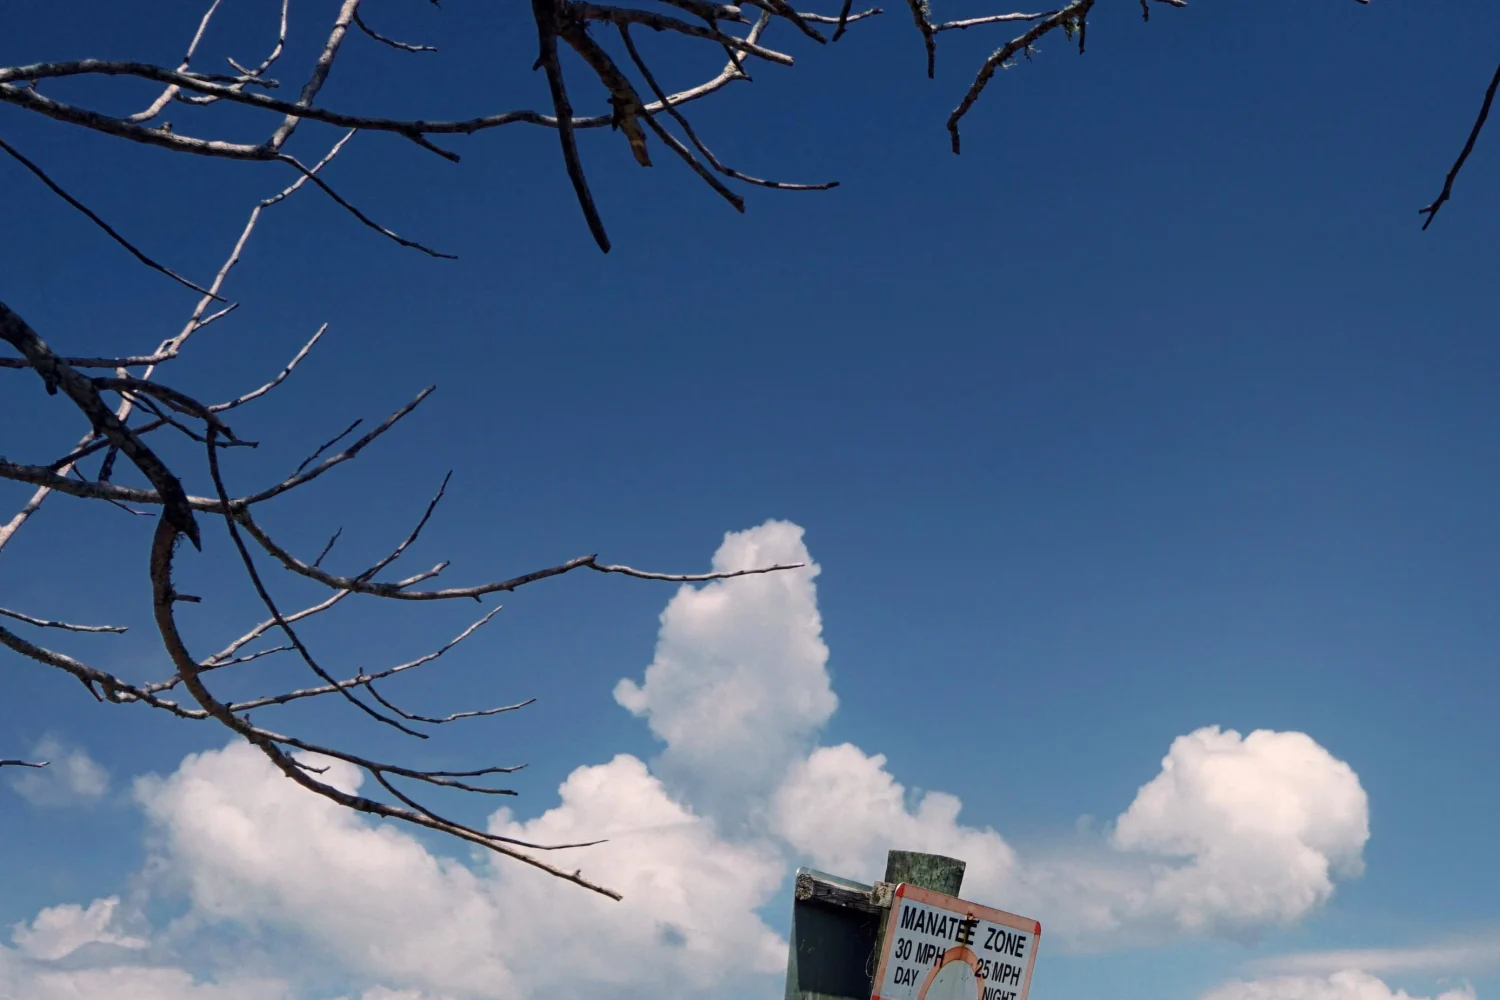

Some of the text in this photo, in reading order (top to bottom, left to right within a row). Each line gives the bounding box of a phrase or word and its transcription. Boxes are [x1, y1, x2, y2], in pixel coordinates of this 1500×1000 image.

[900, 905, 1027, 958] MANATEE ZONE
[895, 938, 946, 968] 30 MPH
[894, 966, 919, 987] DAY
[974, 958, 1021, 986] 25 MPH
